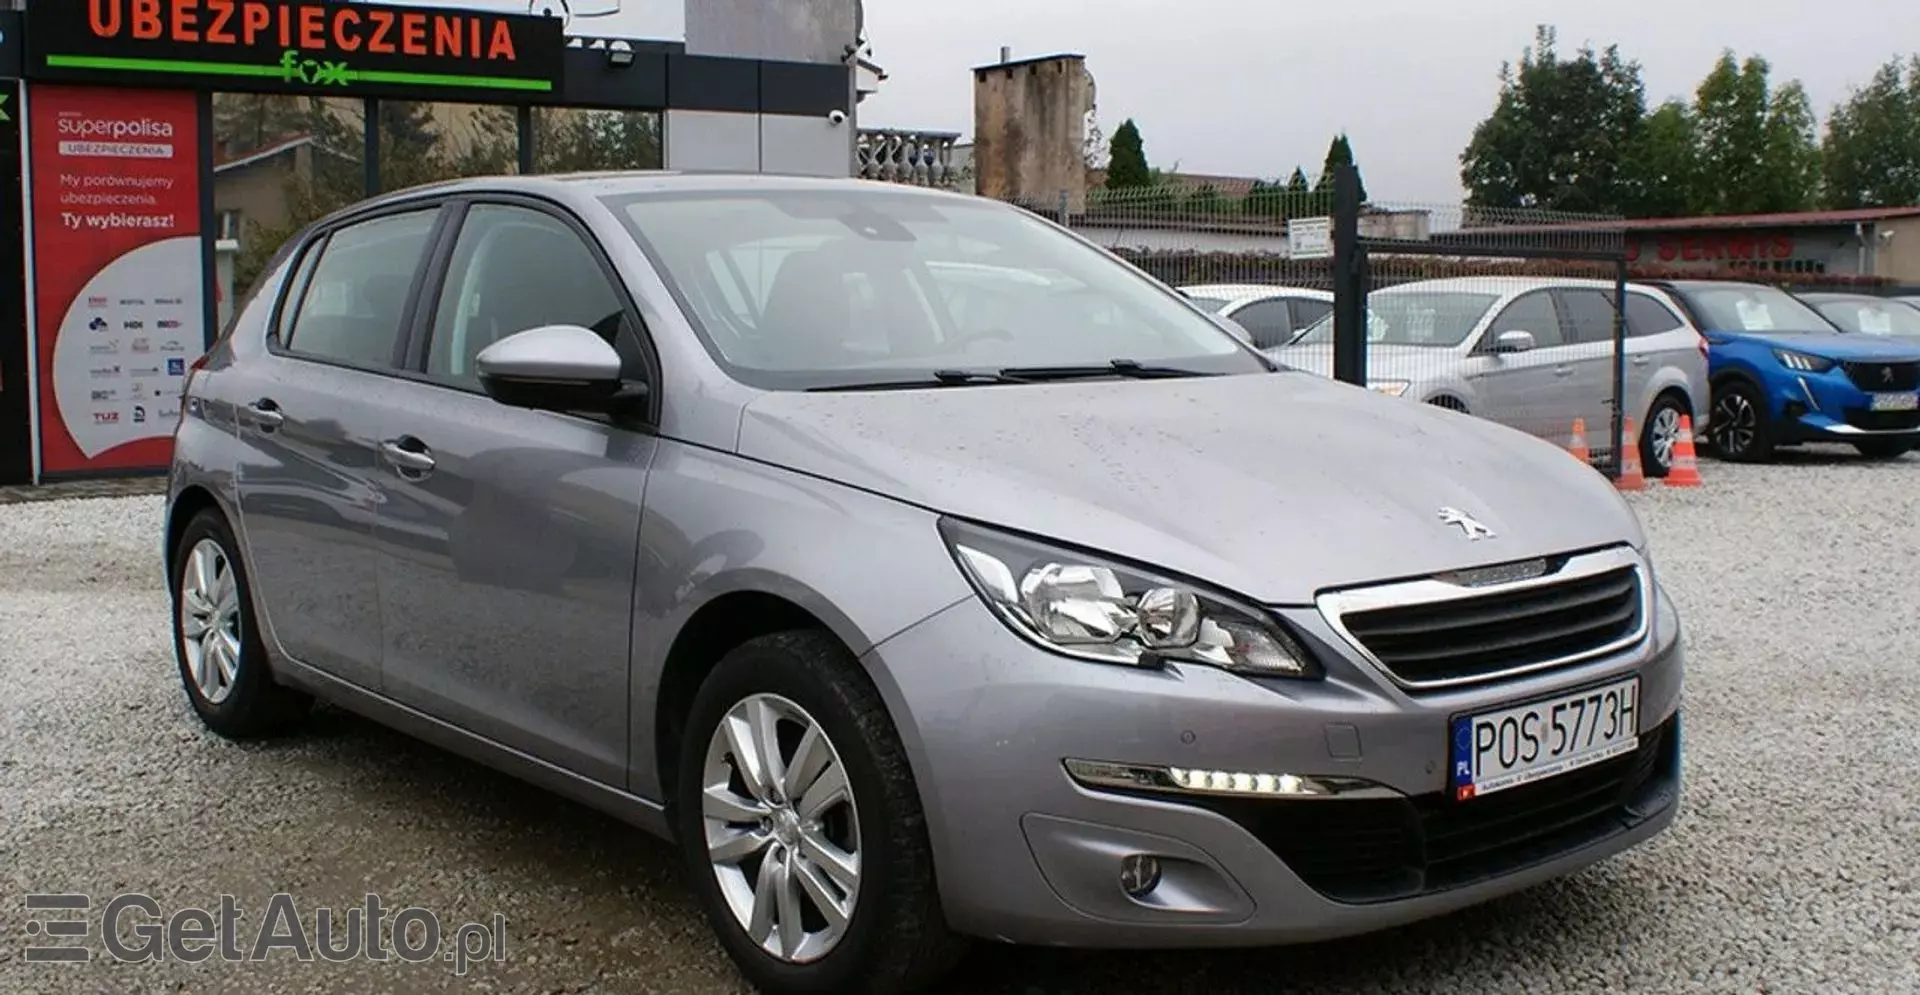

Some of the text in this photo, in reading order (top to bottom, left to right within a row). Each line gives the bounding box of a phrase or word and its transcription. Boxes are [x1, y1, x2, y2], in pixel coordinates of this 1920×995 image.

[89, 0, 516, 61] UBEZPIECZENIA
[58, 118, 173, 139] superpolisa
[67, 143, 165, 155] UBEZPIECZENIA
[60, 173, 173, 189] My porównujemy
[61, 212, 175, 229] Ty wybierasz!
[93, 412, 119, 420] TUZ
[1475, 711, 1540, 777] POS
[1551, 685, 1636, 756] 5773H
[1456, 760, 1471, 777] PL
